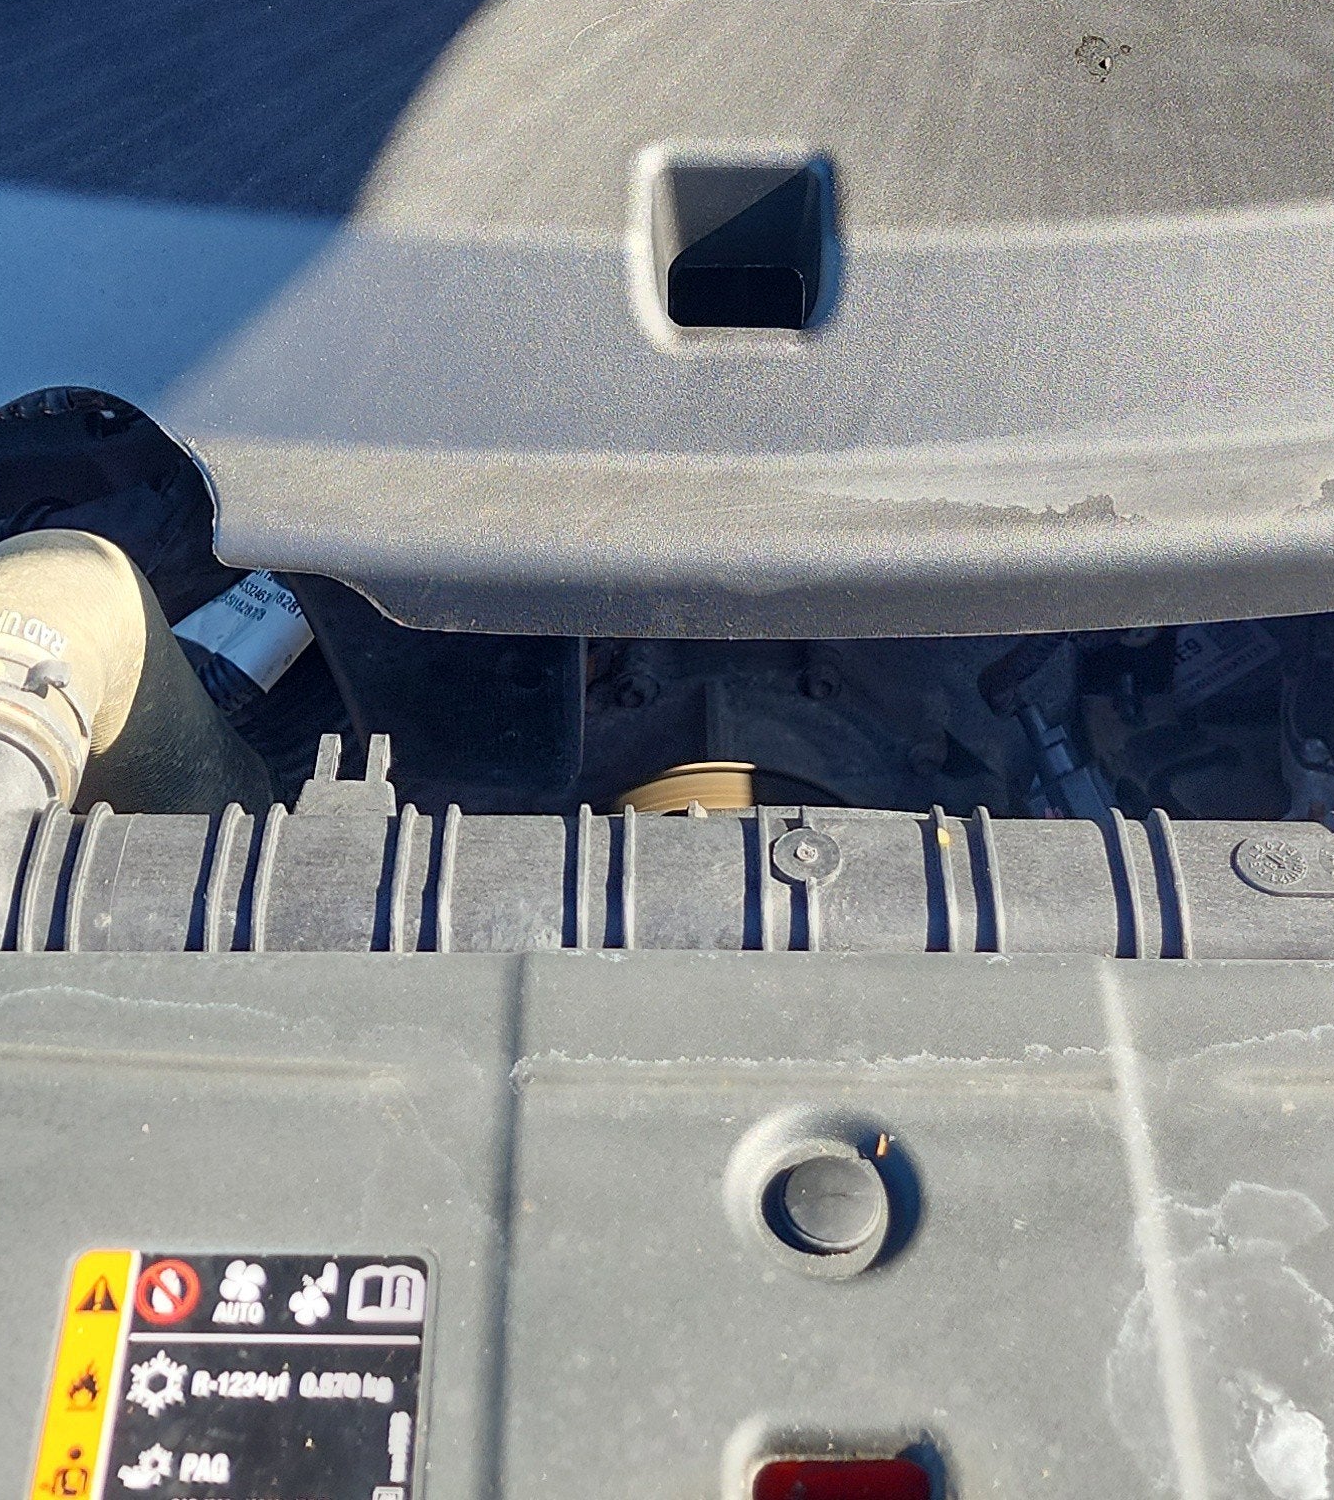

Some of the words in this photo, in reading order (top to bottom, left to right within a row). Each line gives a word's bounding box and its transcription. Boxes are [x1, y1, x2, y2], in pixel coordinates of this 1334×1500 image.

[22, 617, 68, 659] RAD
[212, 1301, 265, 1325] AUTO
[191, 1370, 291, 1402] R-1234yf
